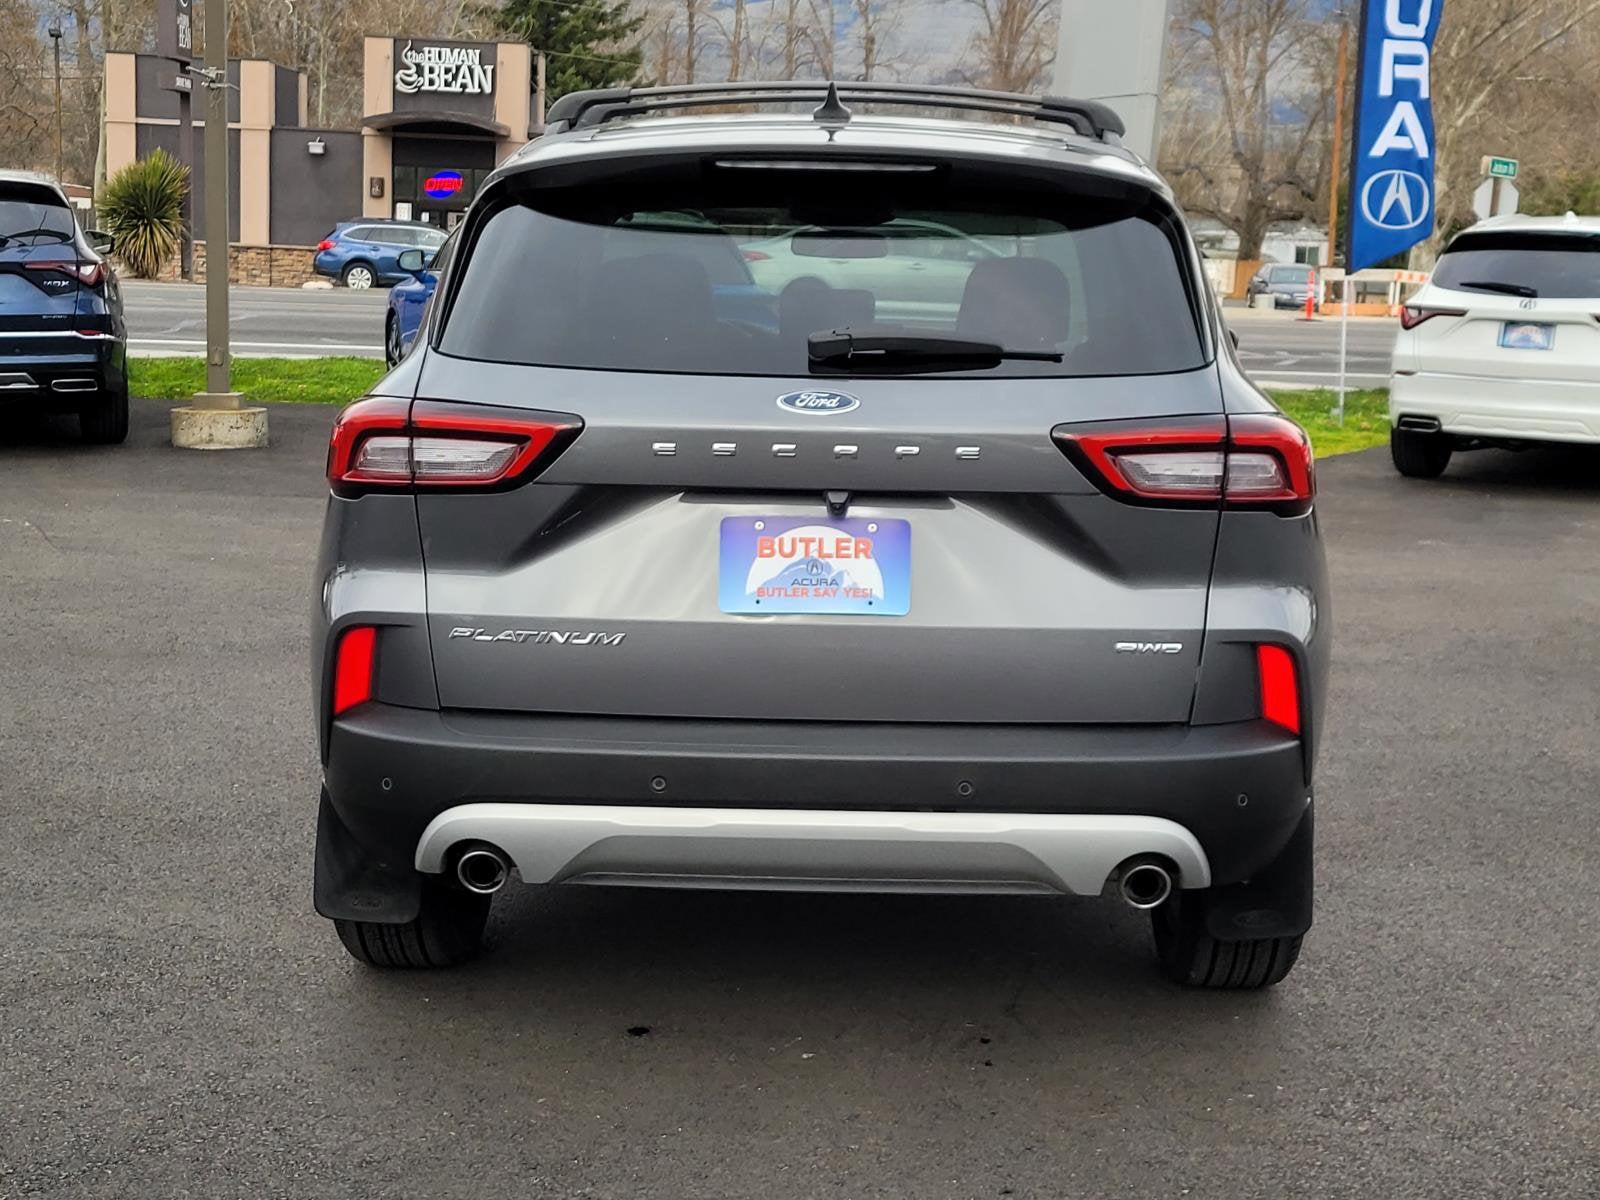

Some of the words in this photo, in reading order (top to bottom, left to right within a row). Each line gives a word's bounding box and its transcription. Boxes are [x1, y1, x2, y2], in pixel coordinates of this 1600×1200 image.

[407, 50, 424, 63] the
[422, 47, 480, 66] HUMAN
[421, 63, 494, 94] BEAN
[424, 177, 464, 192] OPEN
[795, 392, 841, 408] Ford
[652, 442, 981, 460] ESCAPE
[757, 536, 873, 559] BUTLER
[791, 578, 840, 587] ACURA
[756, 587, 809, 598] BUTLER
[813, 587, 839, 599] SAY
[844, 588, 873, 599] YES!
[449, 627, 626, 646] PLATINUM
[1115, 641, 1183, 654] AWD
